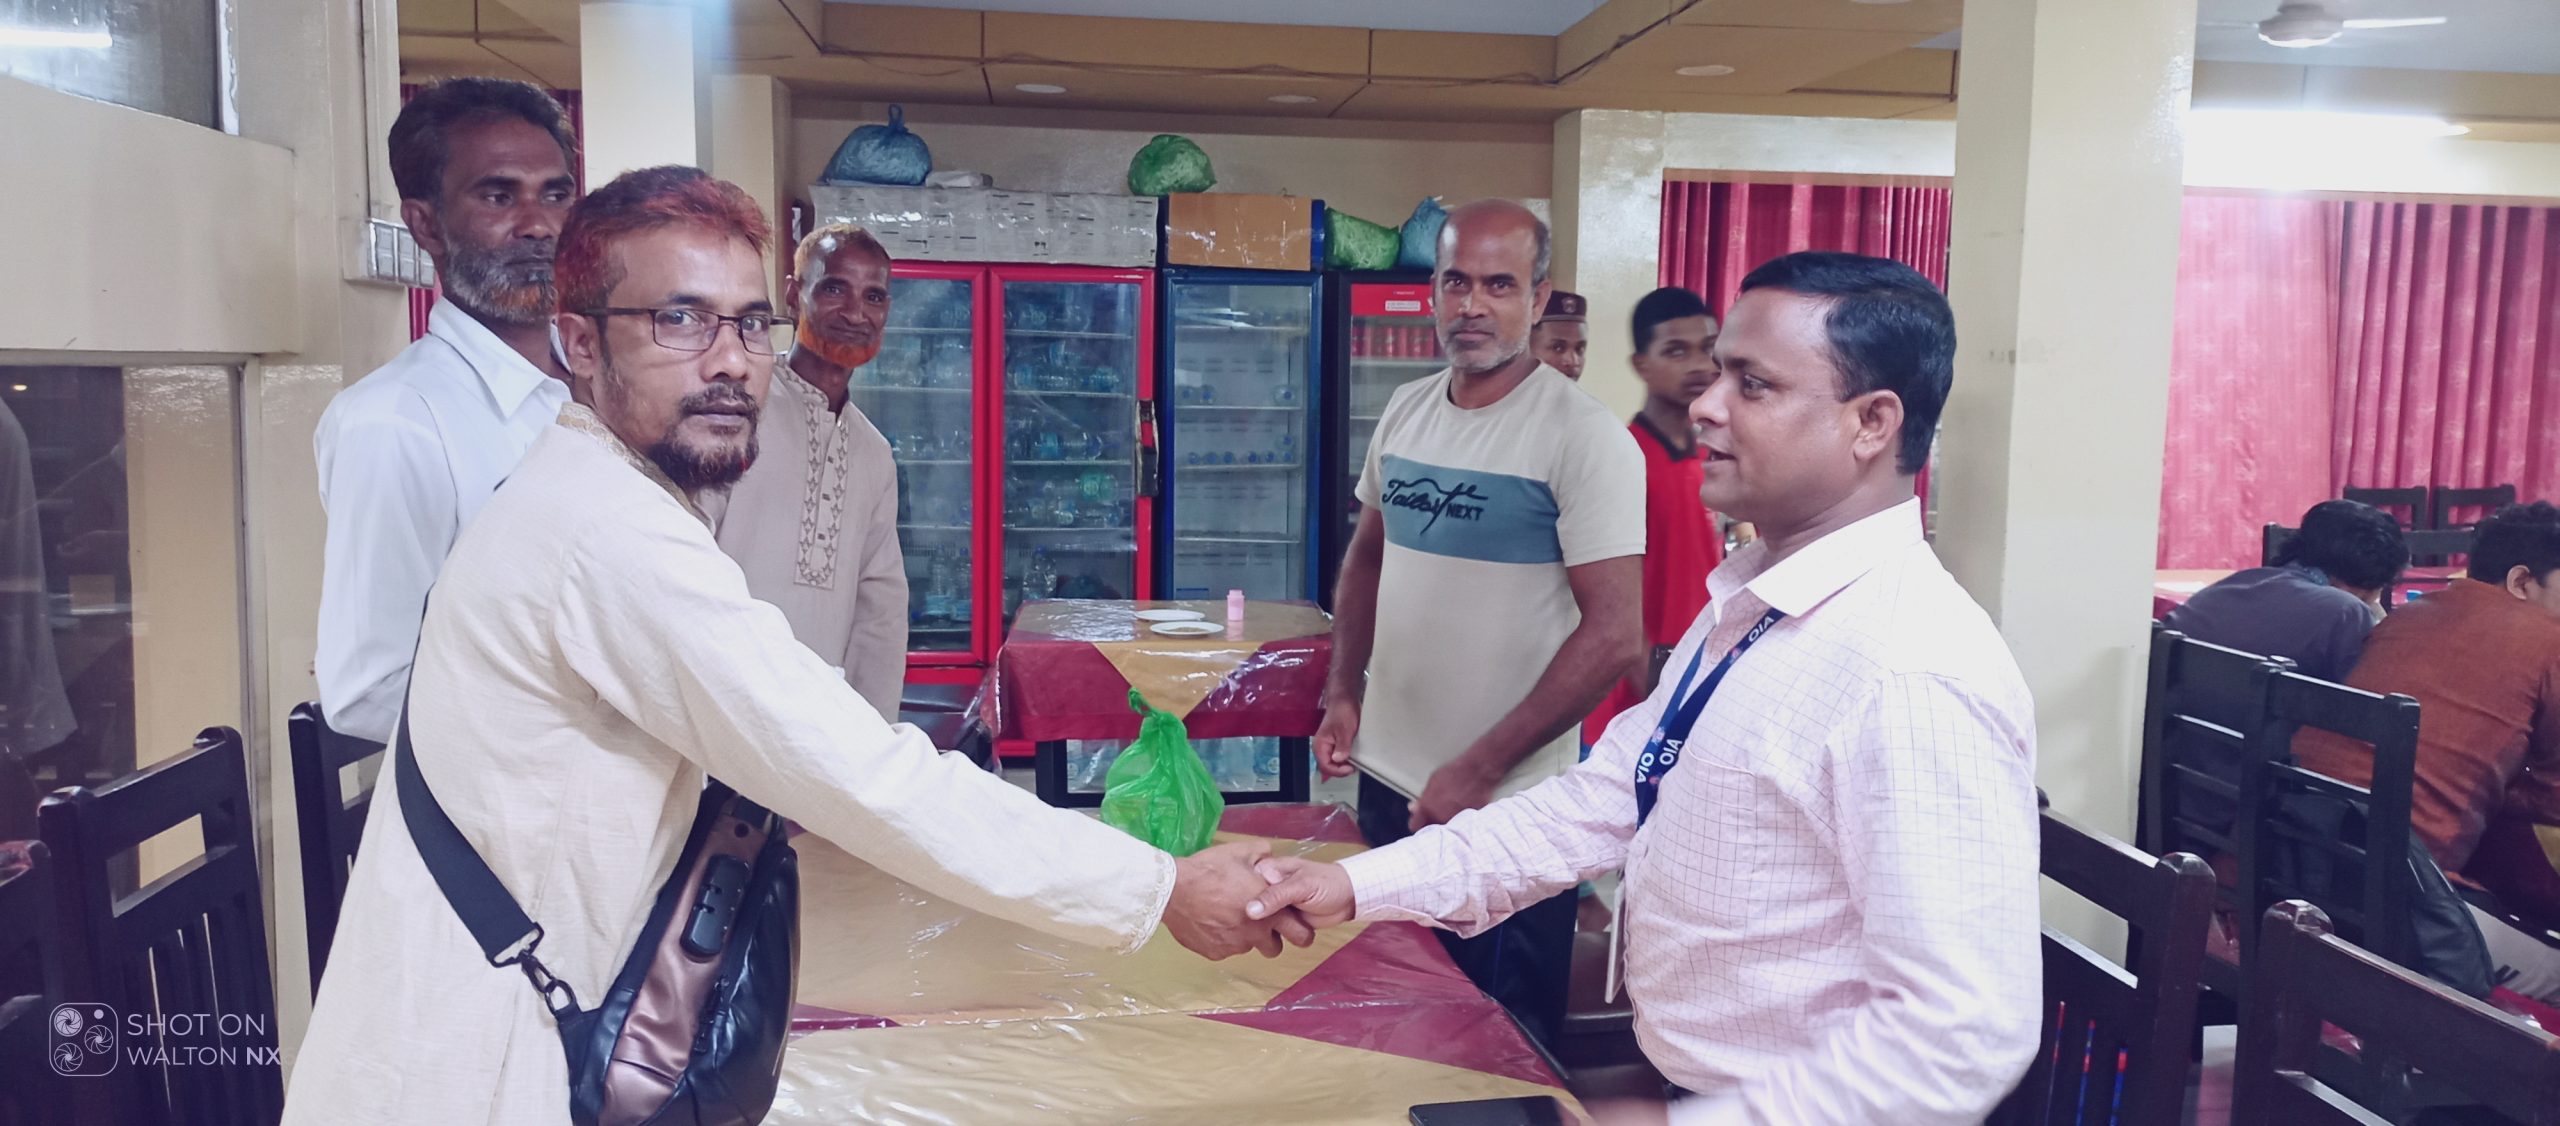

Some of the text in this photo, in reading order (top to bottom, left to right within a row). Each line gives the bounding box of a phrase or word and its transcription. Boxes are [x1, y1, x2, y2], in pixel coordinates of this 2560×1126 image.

[1446, 503, 1484, 521] NEXT
[1748, 616, 1774, 642] OIA
[1659, 739, 1683, 766] OIA
[1637, 752, 1655, 783] OIA
